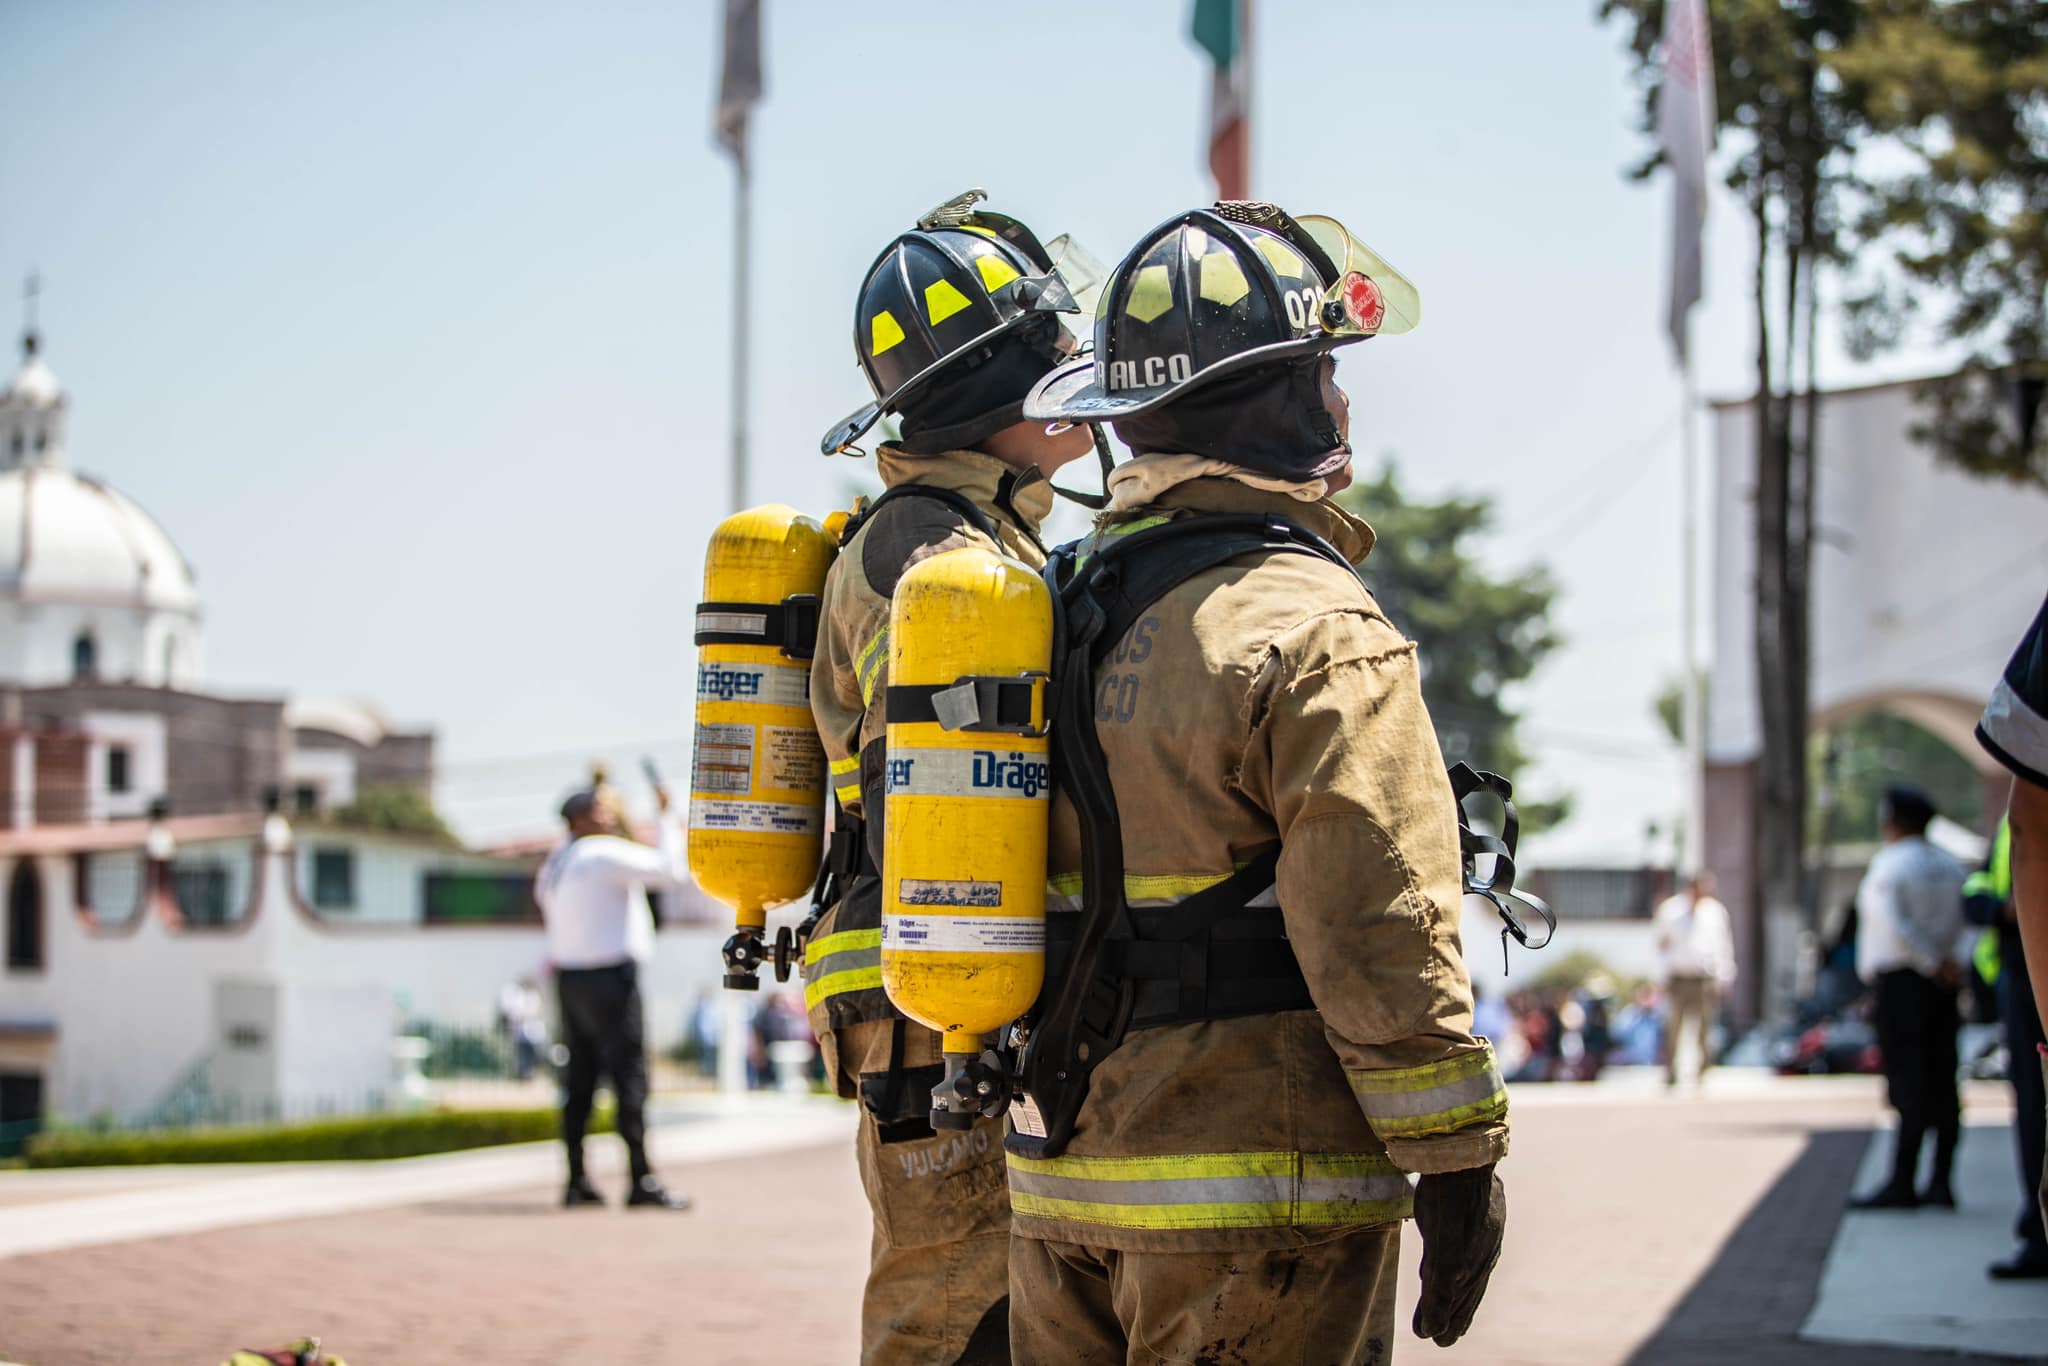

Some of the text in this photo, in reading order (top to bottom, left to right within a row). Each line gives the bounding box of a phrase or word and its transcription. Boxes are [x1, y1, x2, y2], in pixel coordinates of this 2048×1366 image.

[1110, 353, 1192, 391] ALCO
[972, 751, 1049, 798] Dräge
[899, 1128, 987, 1179] VULCANO
